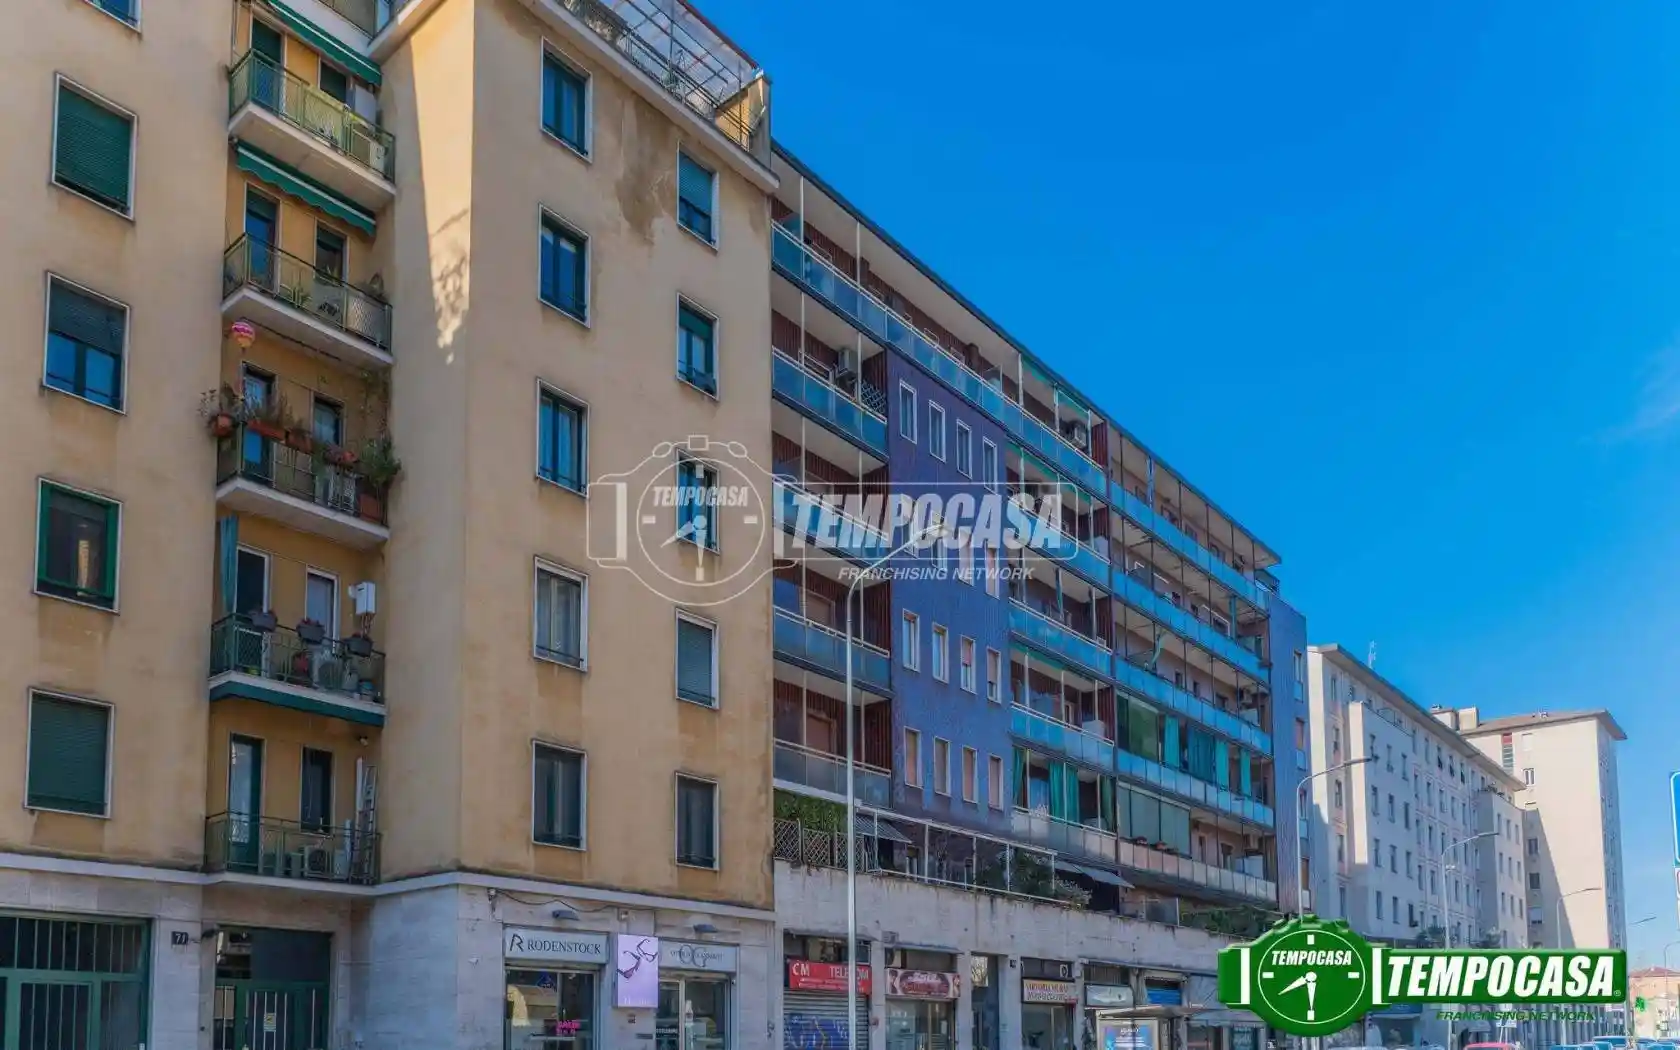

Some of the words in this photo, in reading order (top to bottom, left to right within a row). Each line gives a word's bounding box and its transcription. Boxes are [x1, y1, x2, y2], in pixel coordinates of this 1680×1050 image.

[527, 938, 601, 954] RODENSTOCK
[792, 962, 810, 977] CM
[829, 965, 869, 980] TELEOM
